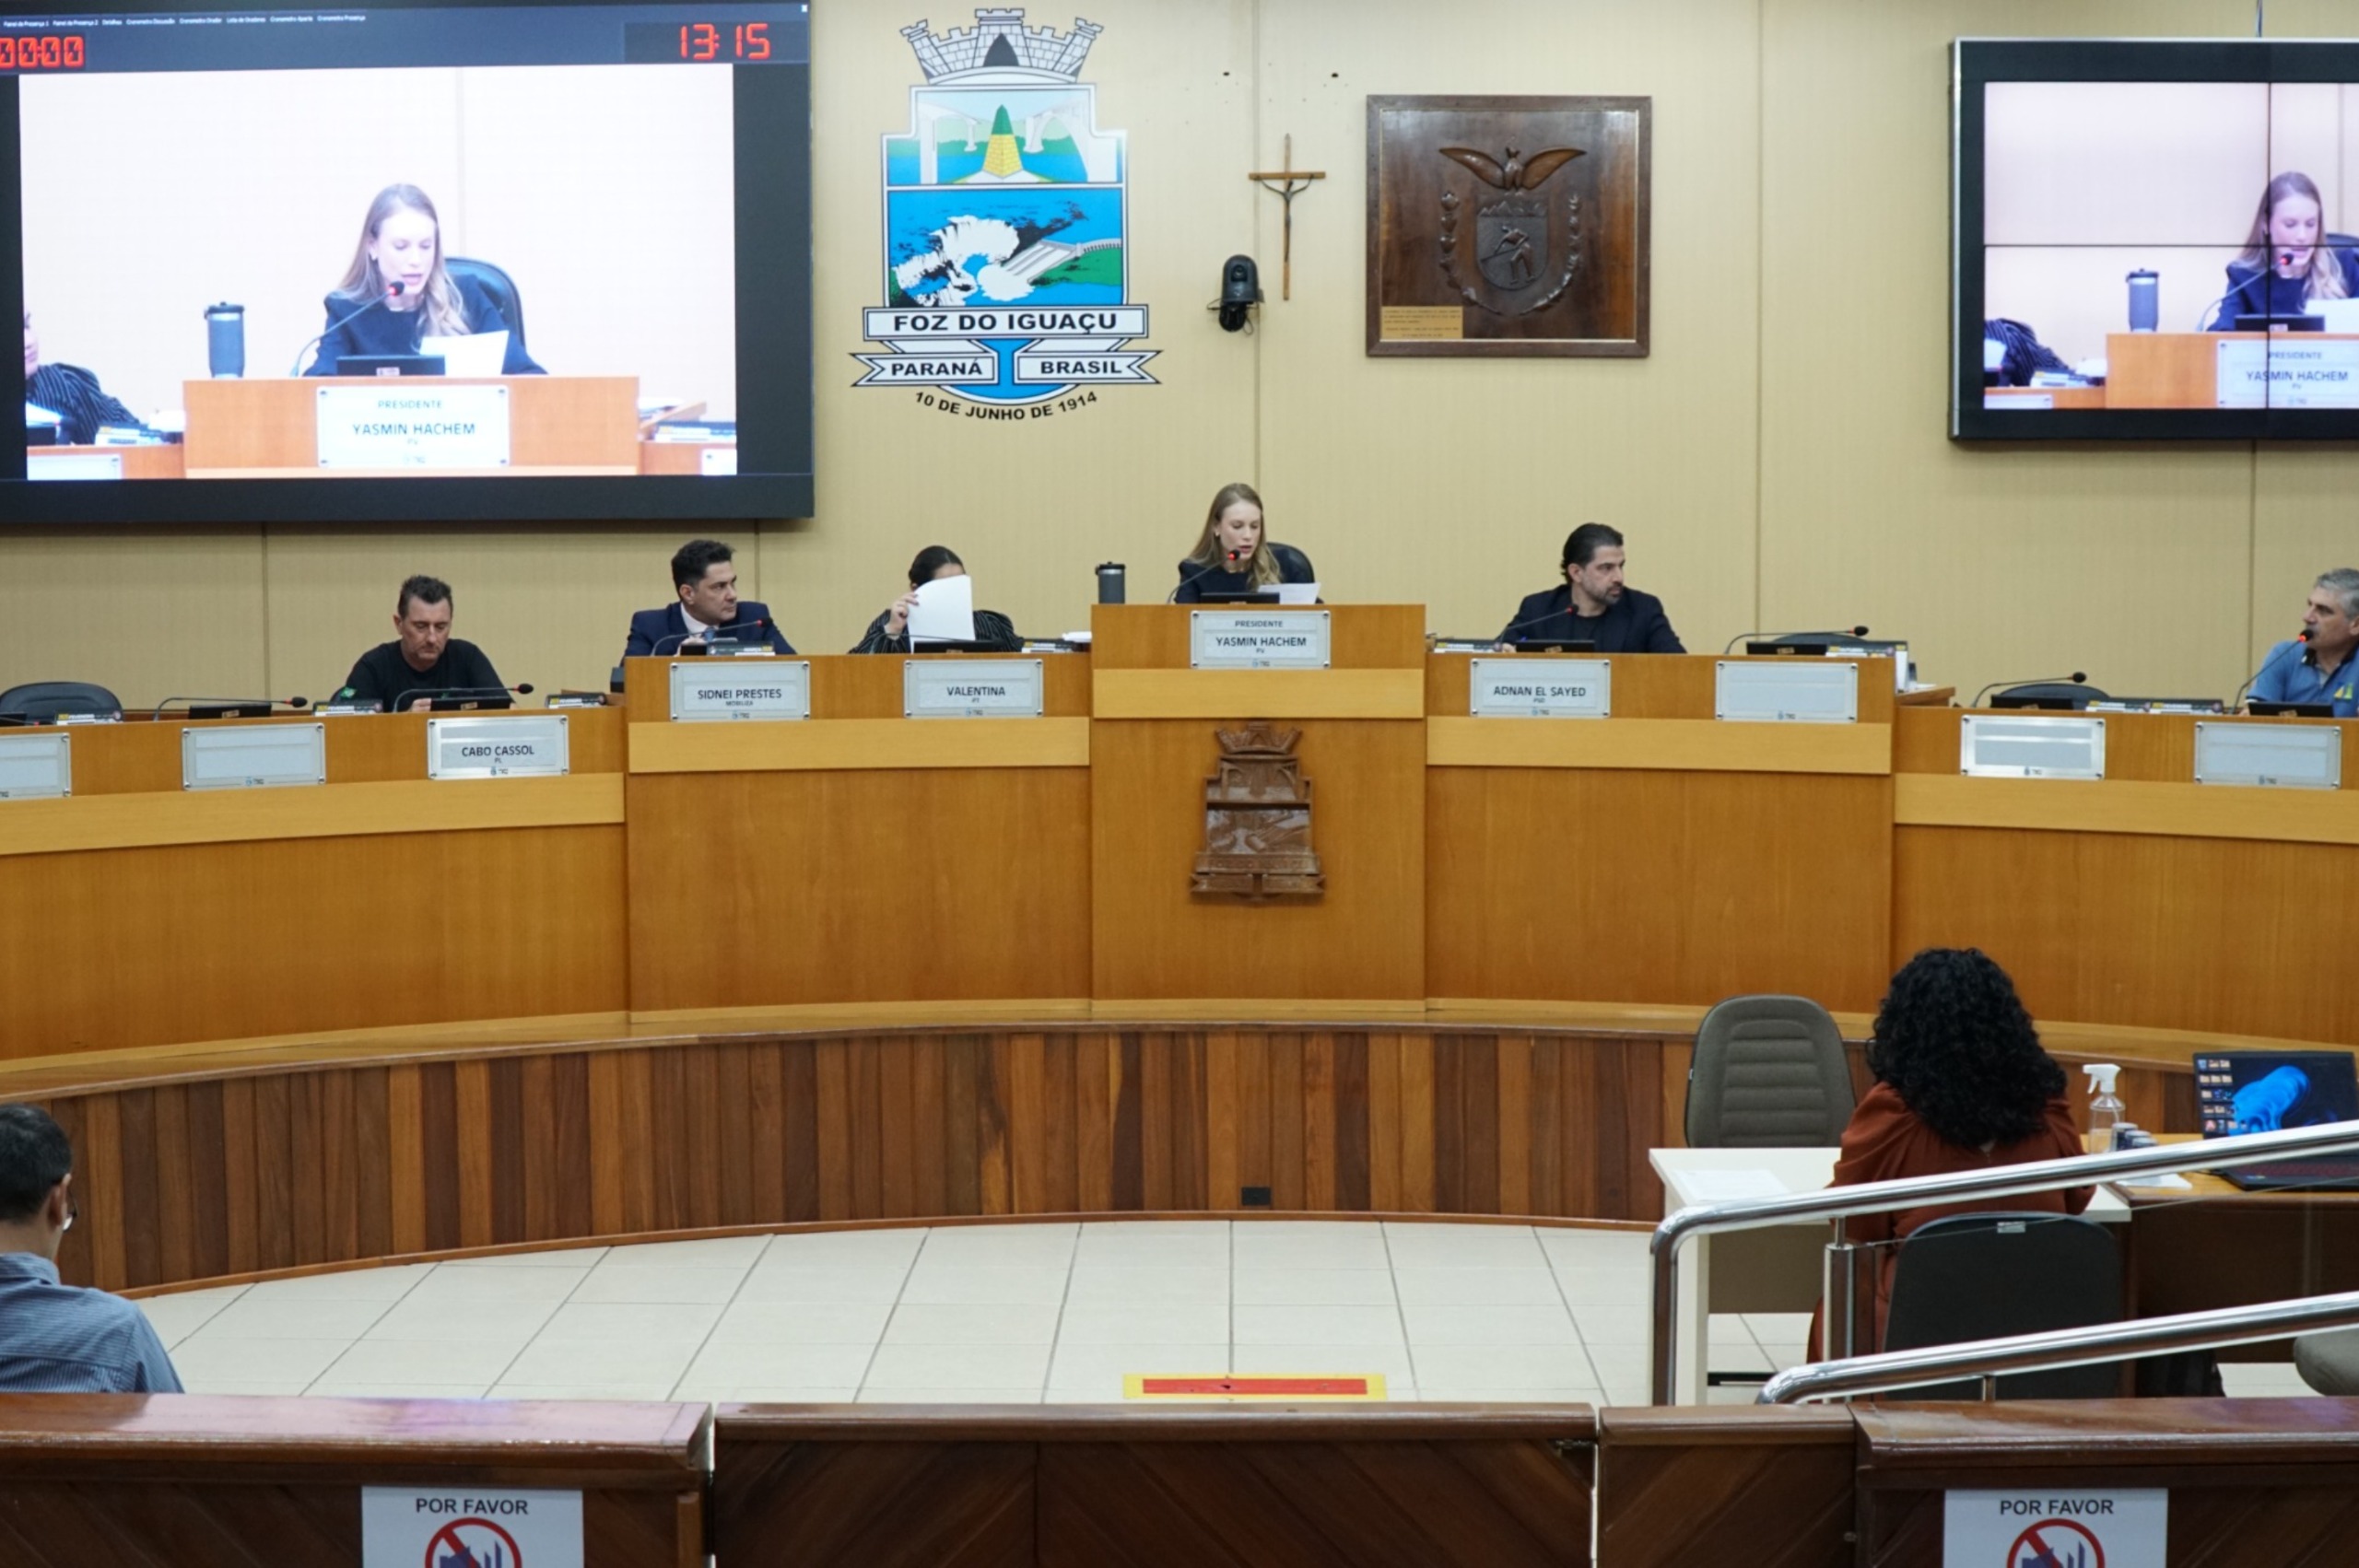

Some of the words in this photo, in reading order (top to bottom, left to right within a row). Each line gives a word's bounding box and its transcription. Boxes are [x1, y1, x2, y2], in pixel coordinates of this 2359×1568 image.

[680, 22, 770, 60] 13:15
[894, 314, 948, 332] FOZ
[958, 314, 997, 331] DO
[1008, 312, 1117, 334] IGUAÇU
[891, 357, 983, 376] PARANÁ
[1040, 360, 1122, 374] BRASIL
[2247, 370, 2293, 380] YASMIN
[2297, 370, 2349, 380] HACHEM
[378, 400, 442, 409] PRESIDENTE
[915, 392, 934, 407] 10
[938, 399, 960, 415] DE
[965, 405, 1026, 420] JUNHO
[1031, 404, 1053, 419] DE
[1058, 391, 1097, 413] 1914
[353, 423, 407, 436] YASMIN
[413, 423, 475, 435] HACHEM
[1215, 637, 1257, 647] YASMIN
[1261, 637, 1307, 647] HACHEM
[698, 689, 732, 700] SIDNEI
[735, 688, 781, 699] PRESTES
[947, 686, 1005, 696] VALENTINA
[1494, 686, 1532, 696] ADNAN
[1535, 686, 1546, 696] EL
[1551, 686, 1586, 696] SAYED
[462, 746, 491, 756] CABO
[494, 745, 534, 756] CASSOL
[416, 1498, 457, 1514] POR
[464, 1499, 529, 1515] FAVOR
[2000, 1500, 2042, 1515] POR
[2048, 1499, 2114, 1515] FAVOR
